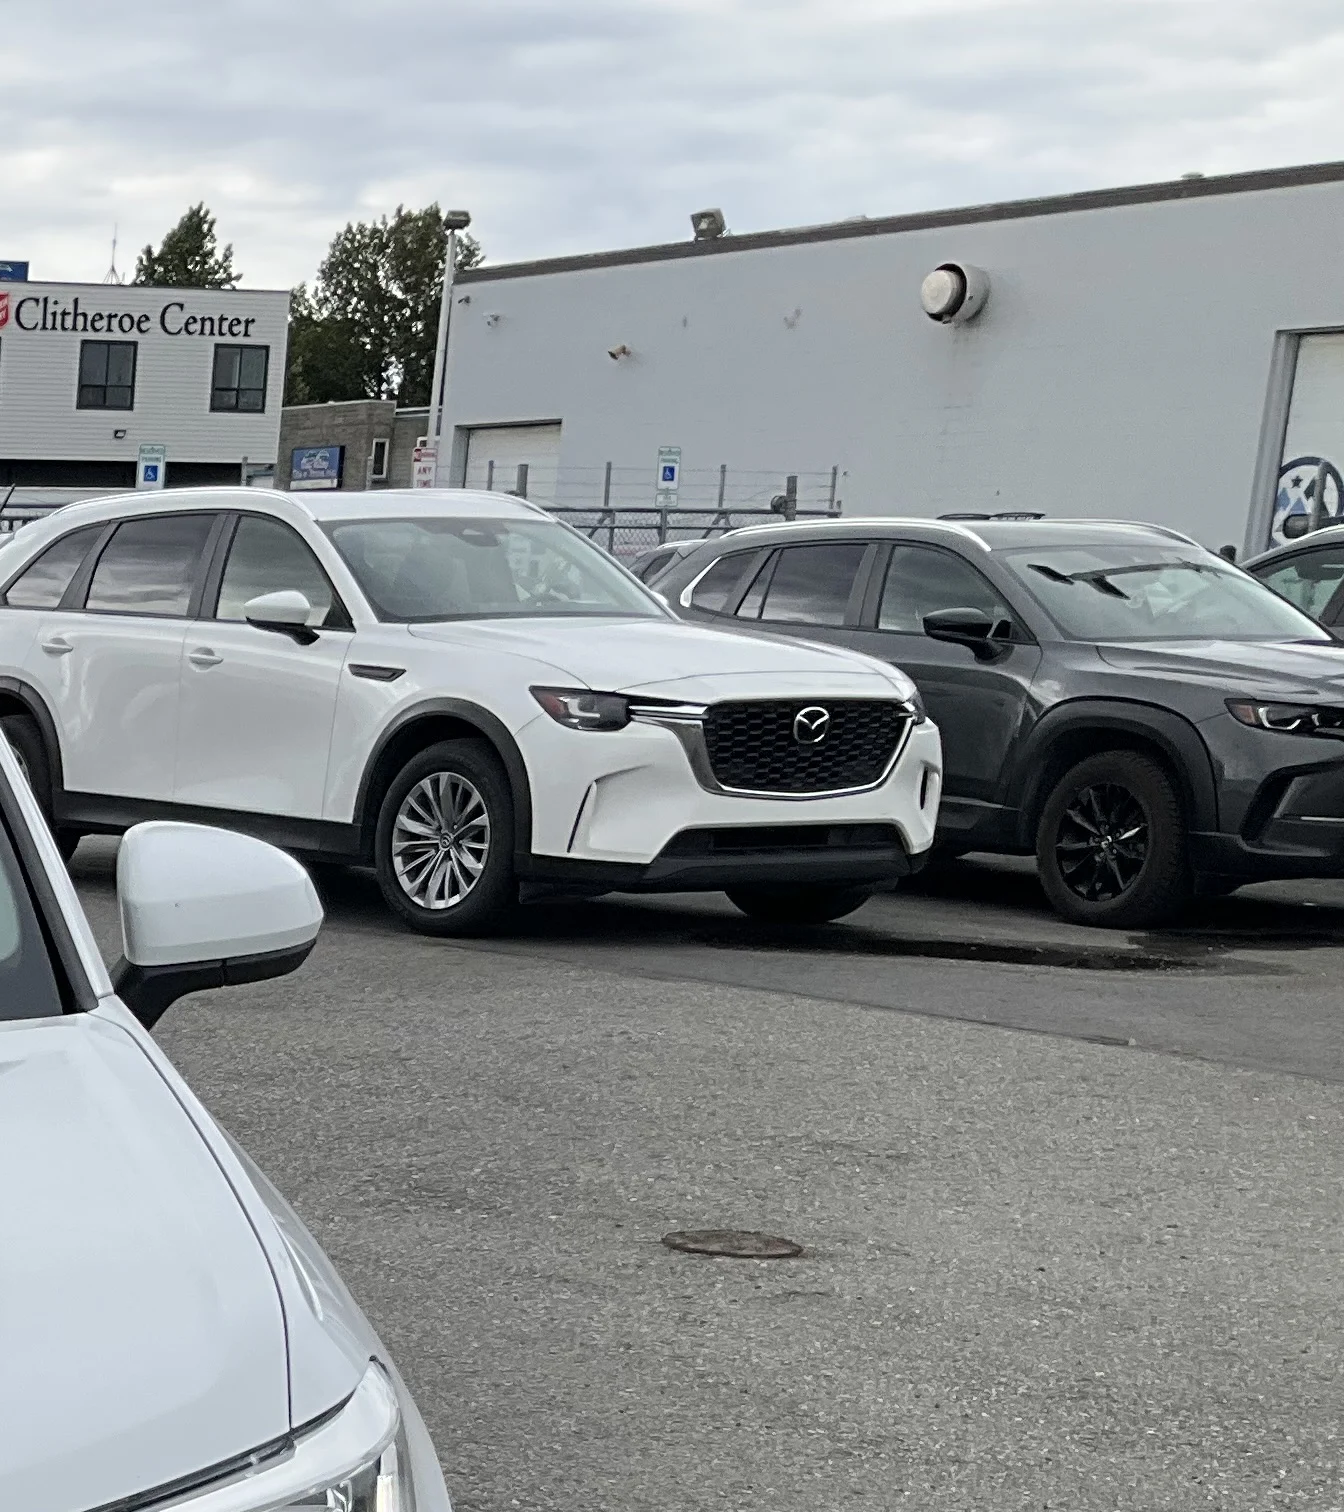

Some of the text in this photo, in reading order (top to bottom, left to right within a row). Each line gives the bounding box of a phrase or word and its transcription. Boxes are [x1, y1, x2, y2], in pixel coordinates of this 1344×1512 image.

[15, 296, 255, 337] Clitheroe Center
[417, 466, 432, 474] ANY
